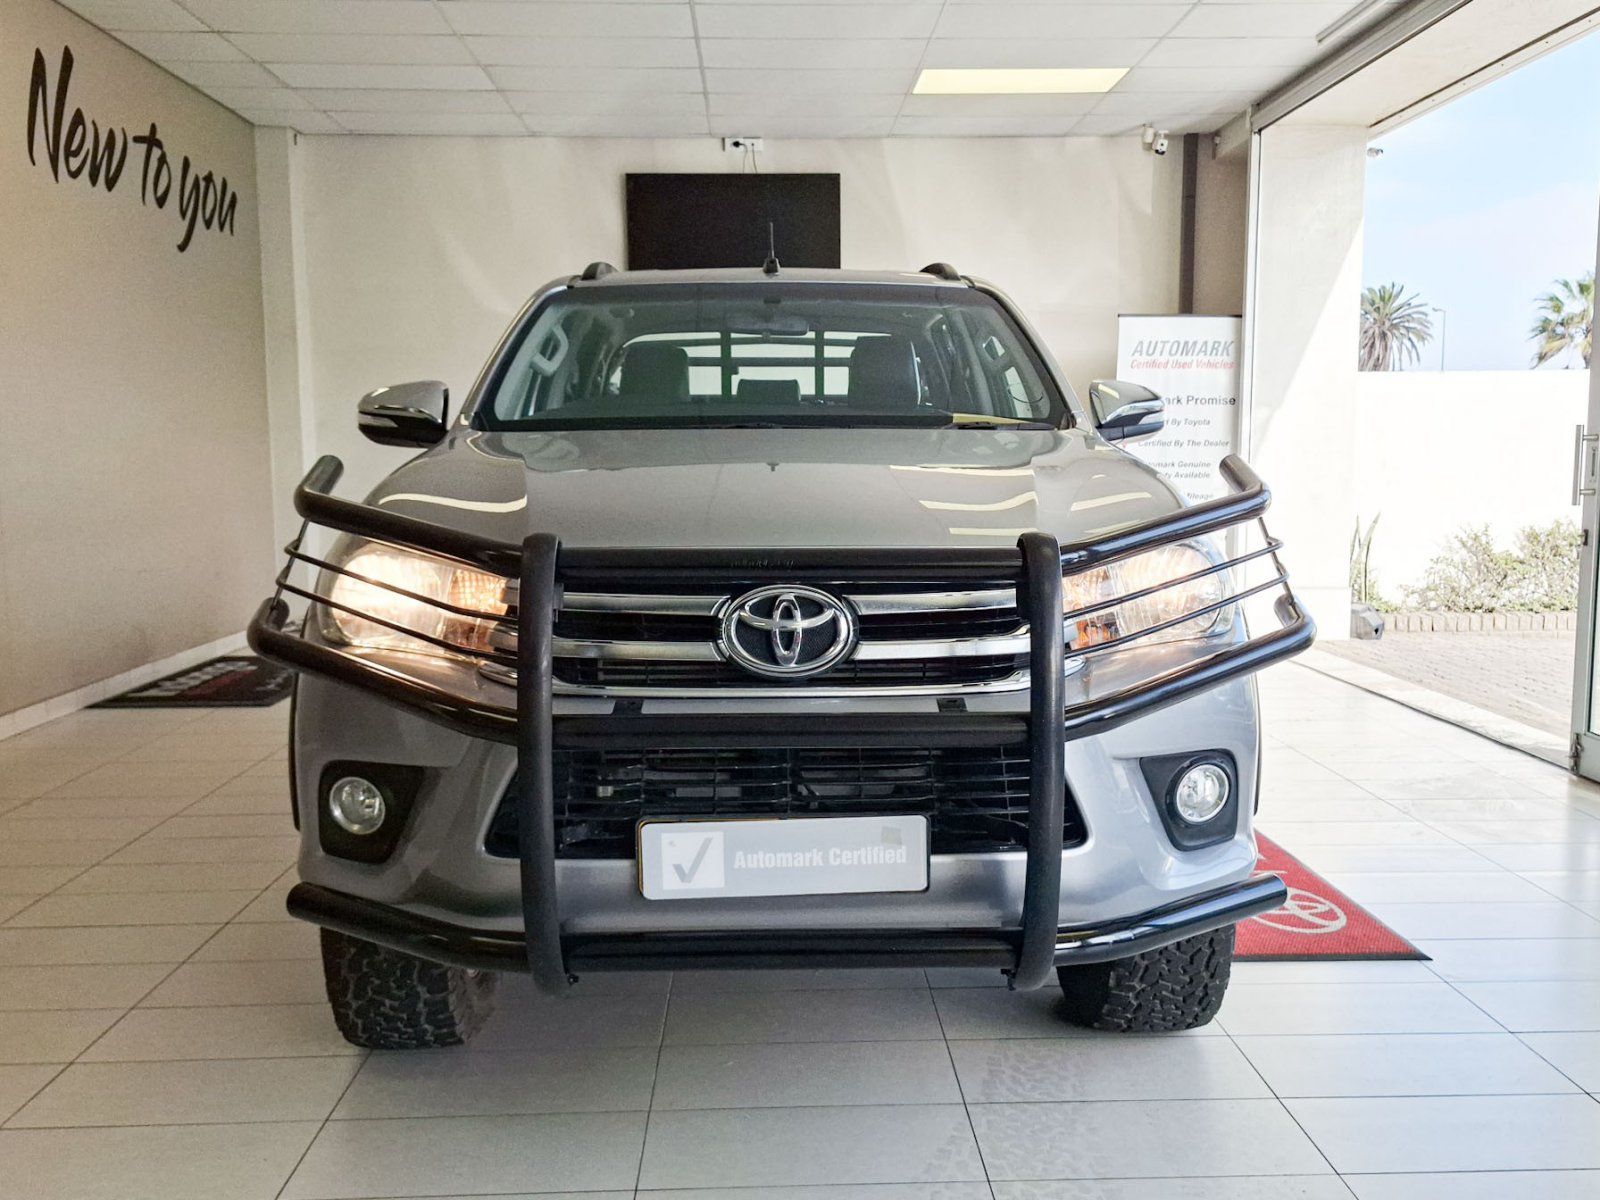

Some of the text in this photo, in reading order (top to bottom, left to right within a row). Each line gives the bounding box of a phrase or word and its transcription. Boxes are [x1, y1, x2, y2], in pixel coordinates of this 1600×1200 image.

[27, 45, 238, 253] New to you
[1131, 340, 1234, 357] AUTOMARK
[1130, 358, 1237, 369] Certified Used Vehicles
[1186, 395, 1236, 406] Promise
[1171, 418, 1182, 427] By
[1184, 418, 1211, 427] Toyota
[1138, 439, 1230, 448] Certified By The Dealer
[1177, 460, 1211, 469] Genuine
[1174, 471, 1211, 479] Available
[733, 845, 907, 870] Automark Certified
